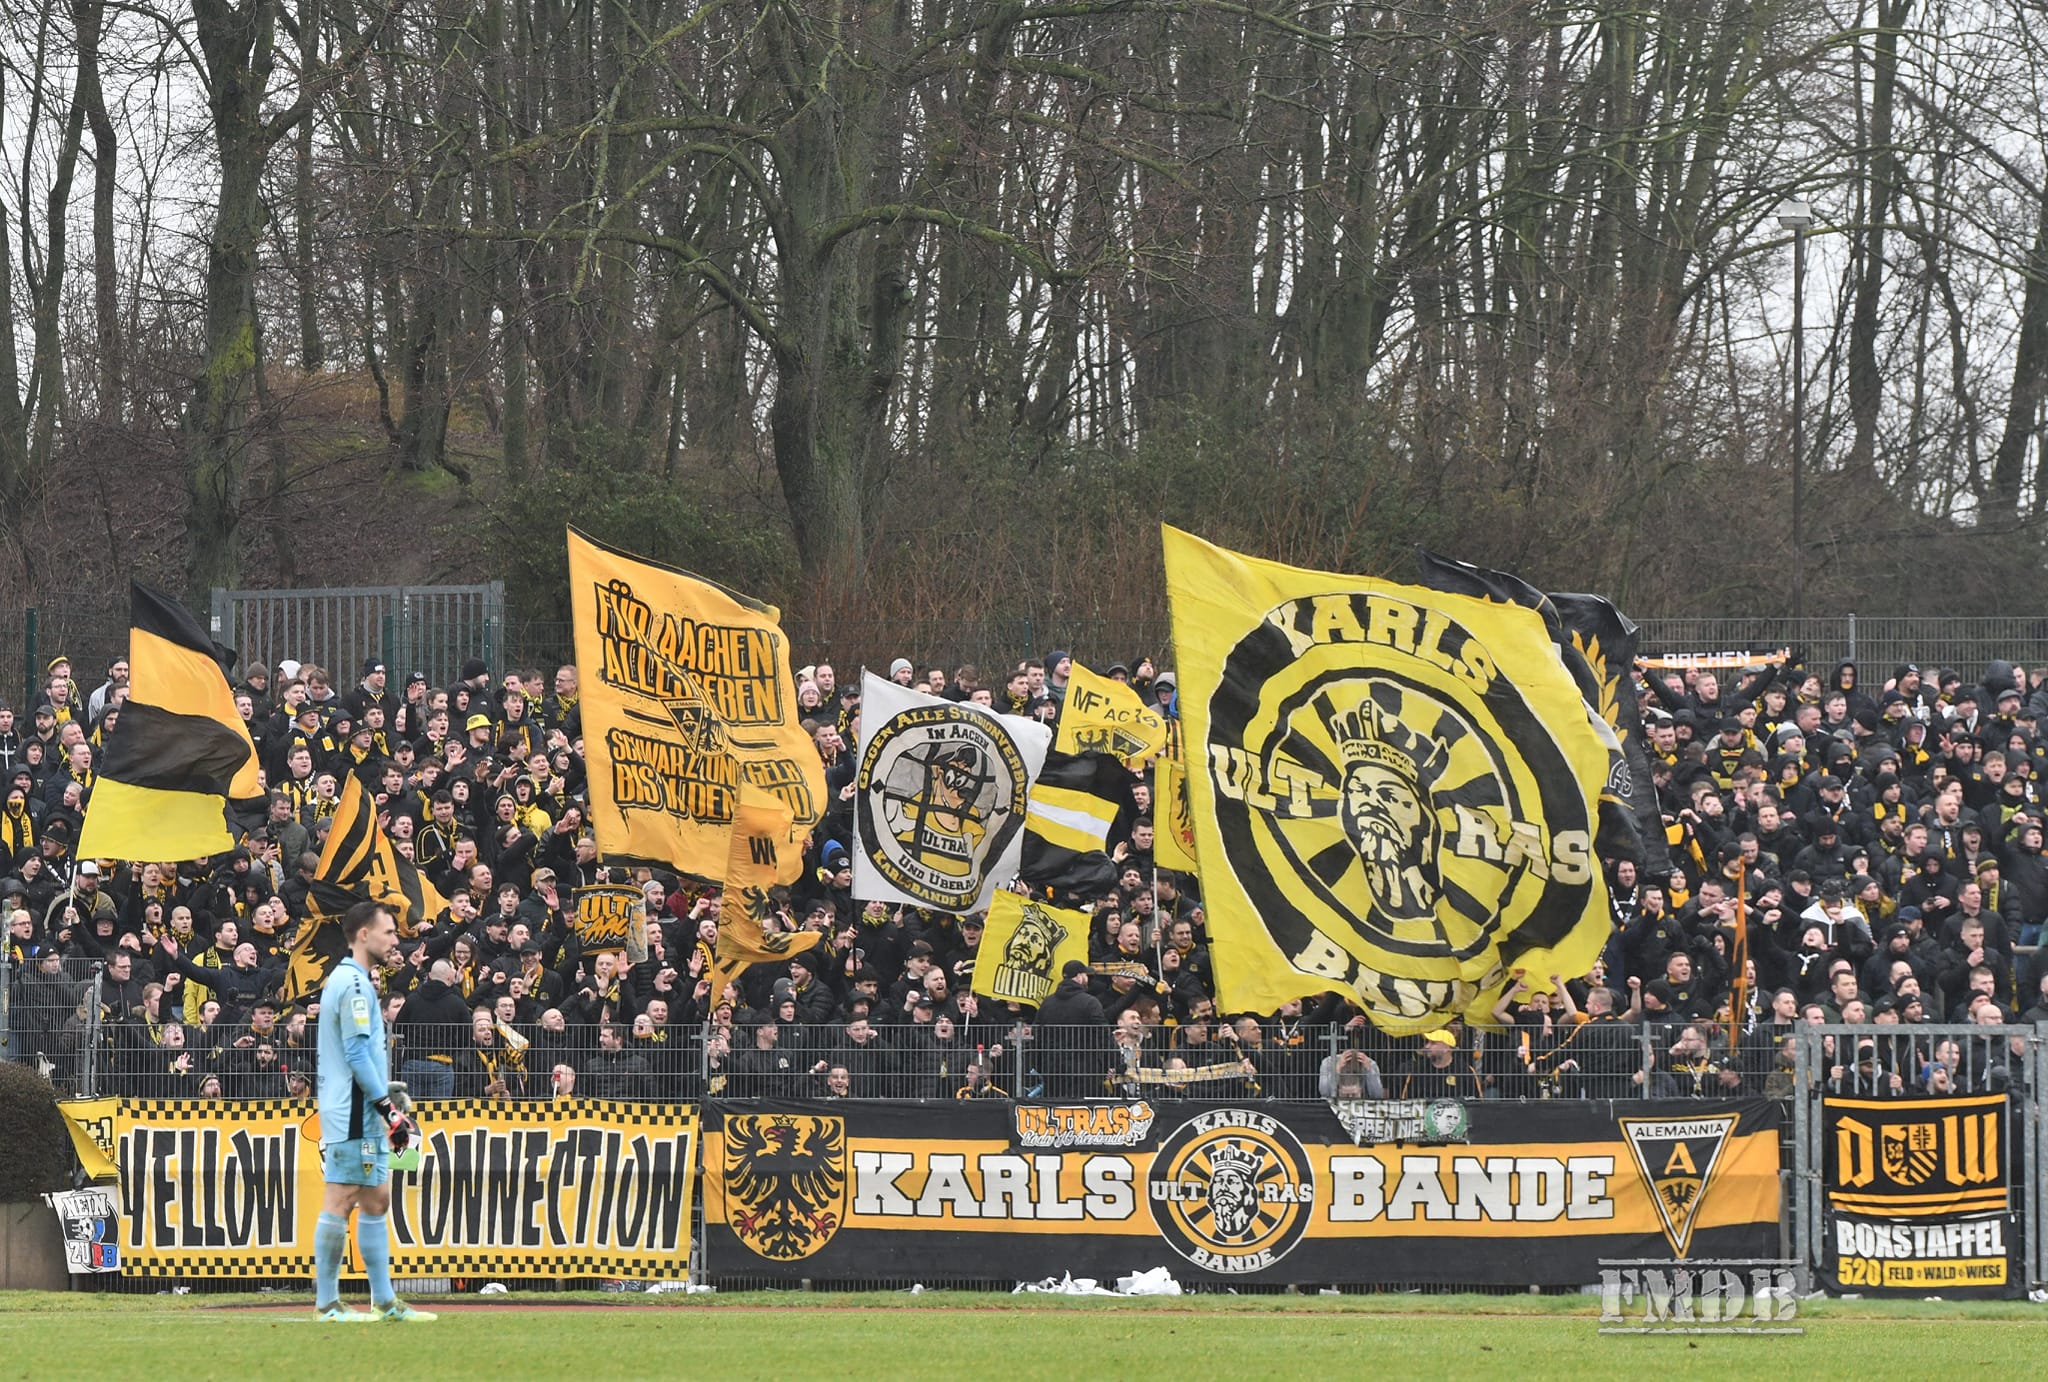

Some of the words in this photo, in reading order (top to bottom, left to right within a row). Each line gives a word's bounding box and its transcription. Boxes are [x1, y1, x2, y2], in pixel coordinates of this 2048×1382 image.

[659, 613, 775, 677] AACHEN
[1268, 595, 1496, 695] KARLS
[1663, 651, 1750, 667] AACHEN
[682, 709, 695, 721] A
[1104, 708, 1130, 722] AC
[926, 727, 946, 740] IN
[949, 724, 989, 749] AACHEN
[859, 727, 895, 790] GEGEN
[896, 710, 945, 729] ALLE
[949, 707, 1024, 816] STADIONVERBOTE
[614, 762, 660, 804] BIS
[1210, 744, 1324, 817] ULT
[1453, 804, 1591, 884] RAS
[872, 849, 957, 906] KARLSBANDE
[899, 855, 924, 880] UND
[929, 871, 976, 890] ÜBERA
[1016, 1106, 1130, 1136] ULTRAS
[1192, 1109, 1277, 1136] KARLS
[1635, 1123, 1724, 1137] ALEMANNIA
[1664, 1142, 1697, 1175] A
[119, 1125, 298, 1248] YELLOW
[391, 1127, 690, 1251] CONNECTION
[853, 1152, 1135, 1220] KARLS
[1329, 1155, 1615, 1221] BANDE
[1151, 1180, 1203, 1203] ULT
[1262, 1180, 1313, 1203] RAS
[63, 1192, 108, 1218] NEIN
[1836, 1219, 2006, 1258] BOXSTAFFEL
[92, 1242, 118, 1267] RB
[1192, 1246, 1277, 1271] BANDE
[1838, 1257, 1882, 1287] 520
[1889, 1266, 1914, 1280] FELD
[1923, 1266, 1957, 1280] WALD
[1966, 1264, 2001, 1279] WIESE
